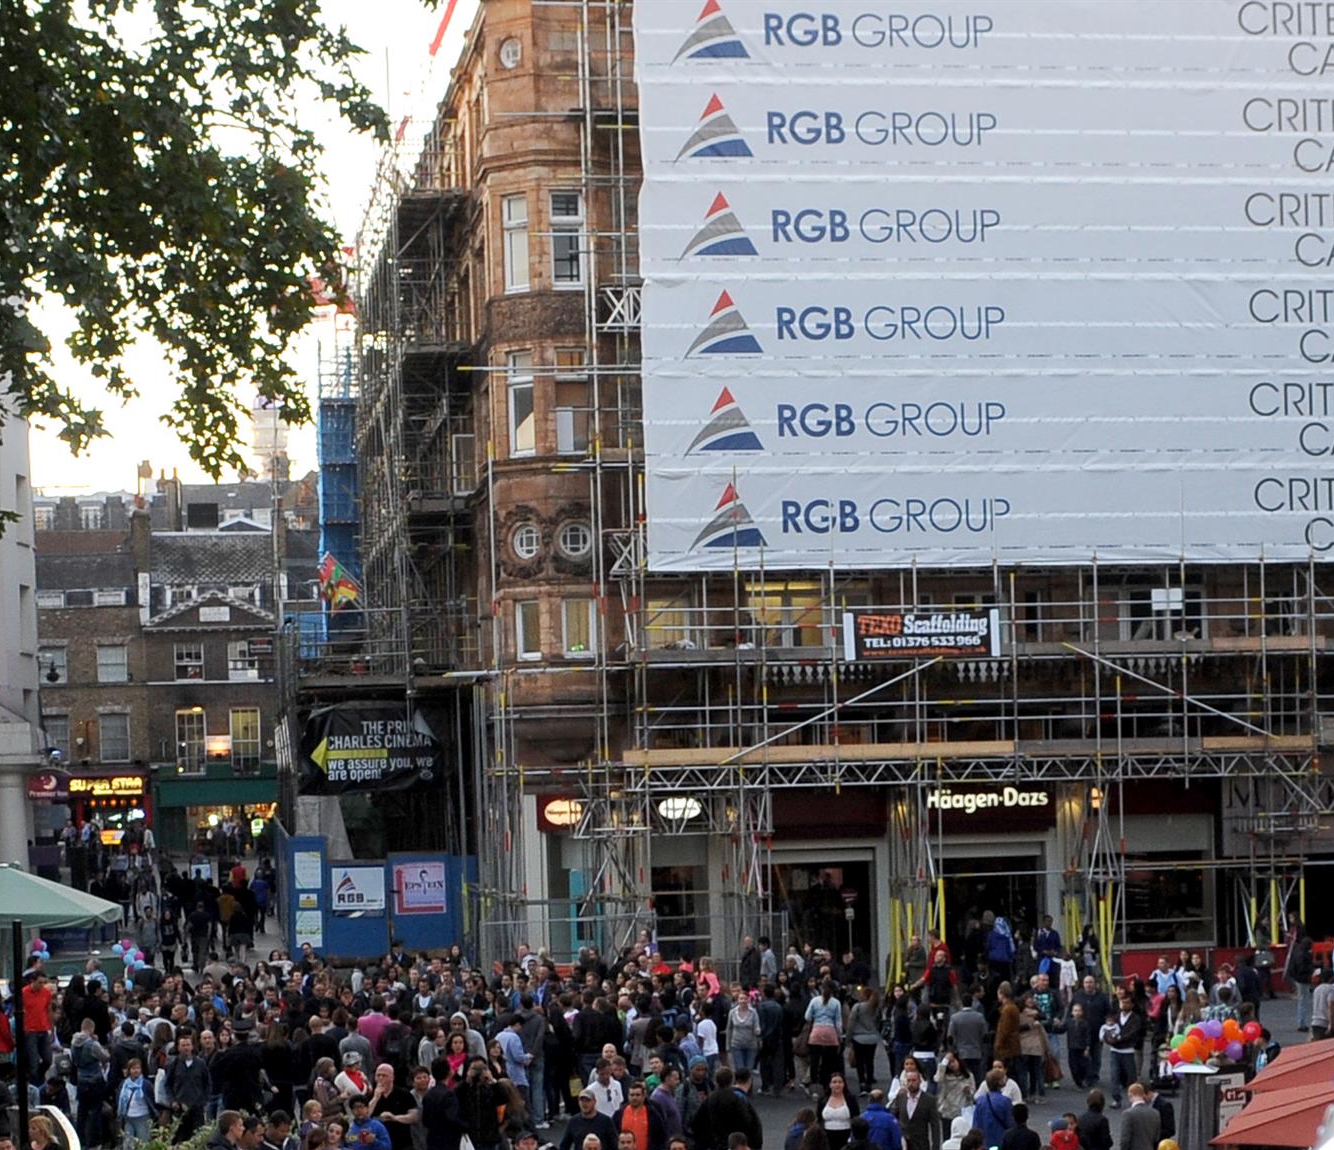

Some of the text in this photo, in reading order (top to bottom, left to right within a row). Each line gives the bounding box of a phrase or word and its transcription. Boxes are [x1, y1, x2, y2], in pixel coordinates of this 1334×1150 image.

[764, 13, 993, 49] RGB GROUP
[767, 111, 997, 147] RGB GROUP
[771, 208, 1001, 244] RGB GROUP
[776, 305, 1005, 341] RGB GROUP
[777, 402, 1006, 438] RGB GROUP
[781, 498, 1011, 534] RGB GROUP
[903, 613, 989, 636] Scaffolding
[863, 634, 982, 648] TEL: 01376 533 966
[327, 734, 383, 750] CHARLES
[361, 720, 385, 735] THE
[327, 756, 434, 772] we assure you, we
[327, 769, 382, 783] are open!
